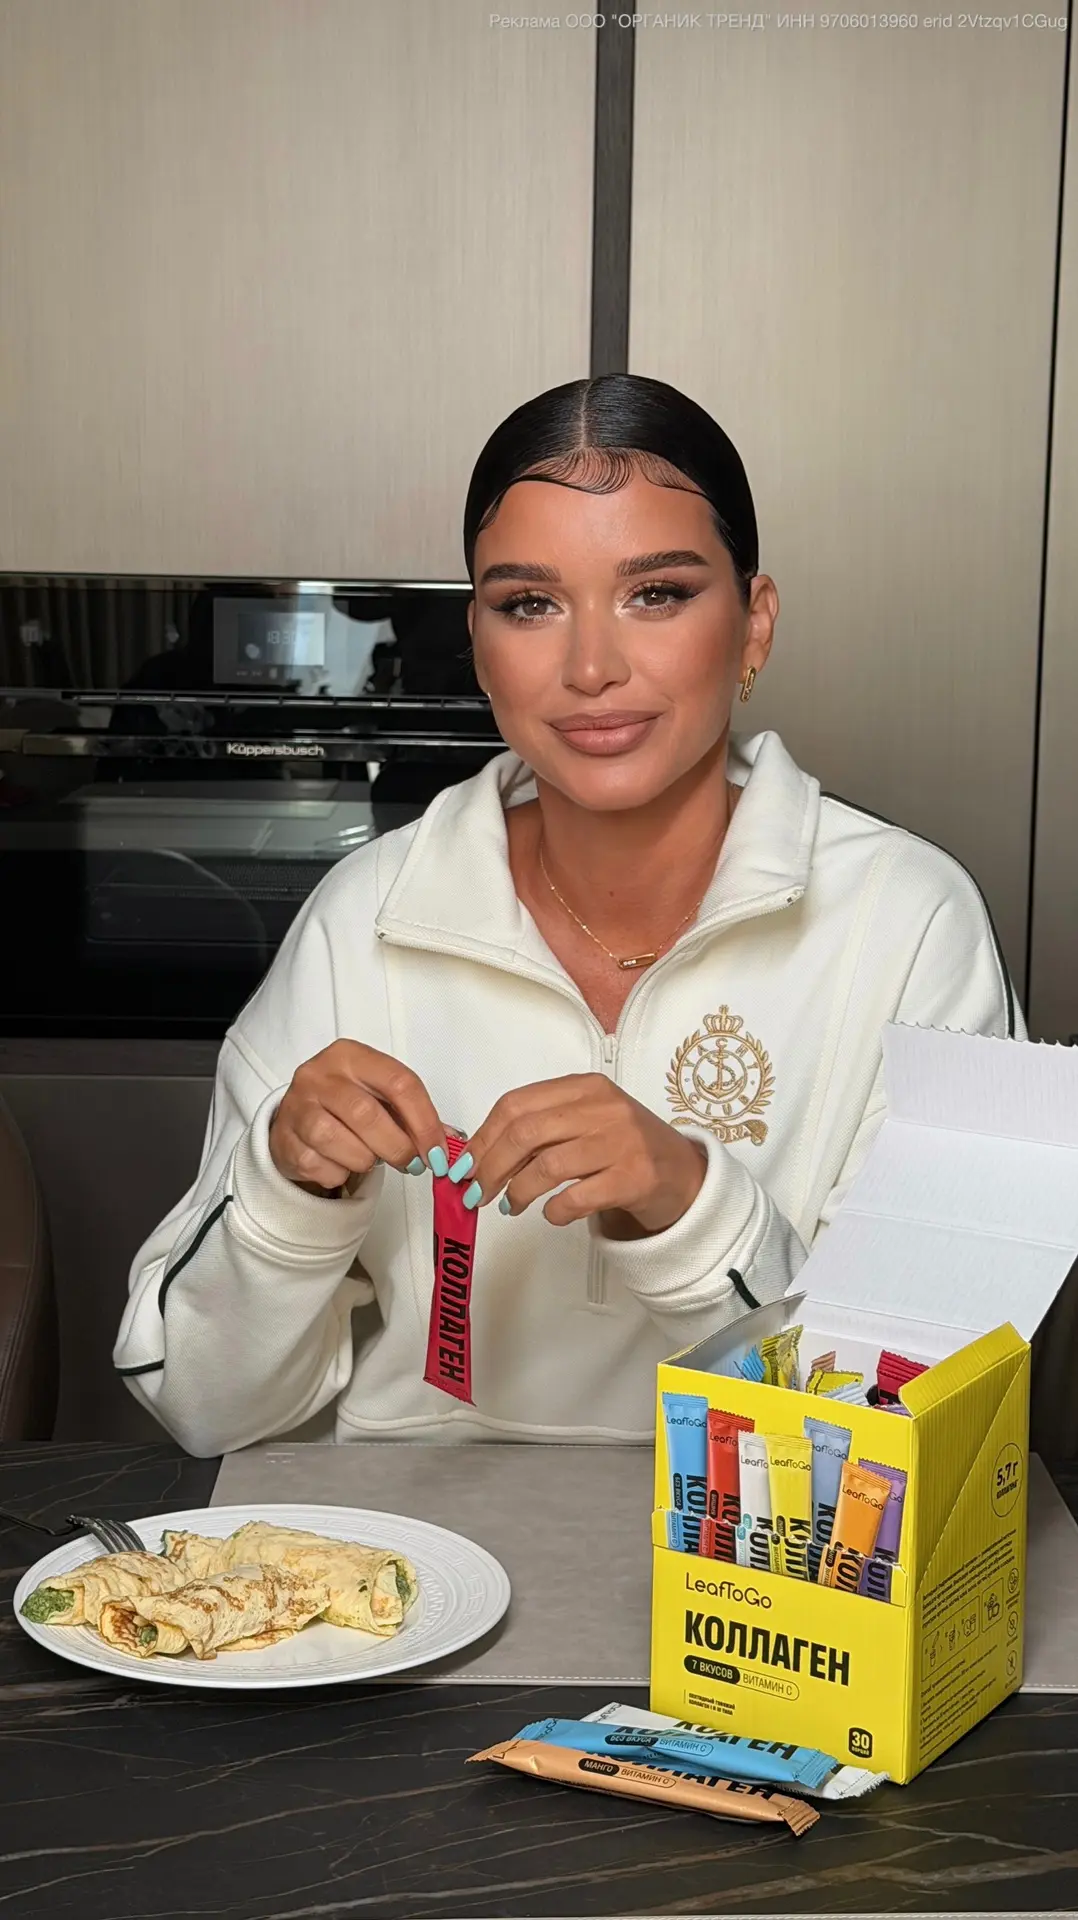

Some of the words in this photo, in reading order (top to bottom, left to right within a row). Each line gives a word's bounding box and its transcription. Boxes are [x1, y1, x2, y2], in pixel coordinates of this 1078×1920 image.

[227, 742, 325, 757] Küppersbusch
[688, 1091, 750, 1116] CLUB
[439, 1237, 471, 1384] КОЛЛАГЕН
[666, 1414, 708, 1428] LeafToGo
[770, 1456, 812, 1472] LeafToGo
[996, 1461, 1011, 1487] 5,7
[842, 1483, 884, 1511] LeafToGo
[685, 1572, 772, 1609] LeafToGo
[684, 1609, 850, 1687] КОЛЛАГЕН
[692, 1659, 697, 1670] 7
[700, 1661, 733, 1680] ВКУСОВ
[743, 1673, 784, 1693] ВИТАМИН
[659, 1739, 699, 1751] ВИТАМИН
[851, 1731, 870, 1750] 30
[583, 1760, 614, 1773] МАНГО
[620, 1768, 661, 1783] ВИТАМИН
